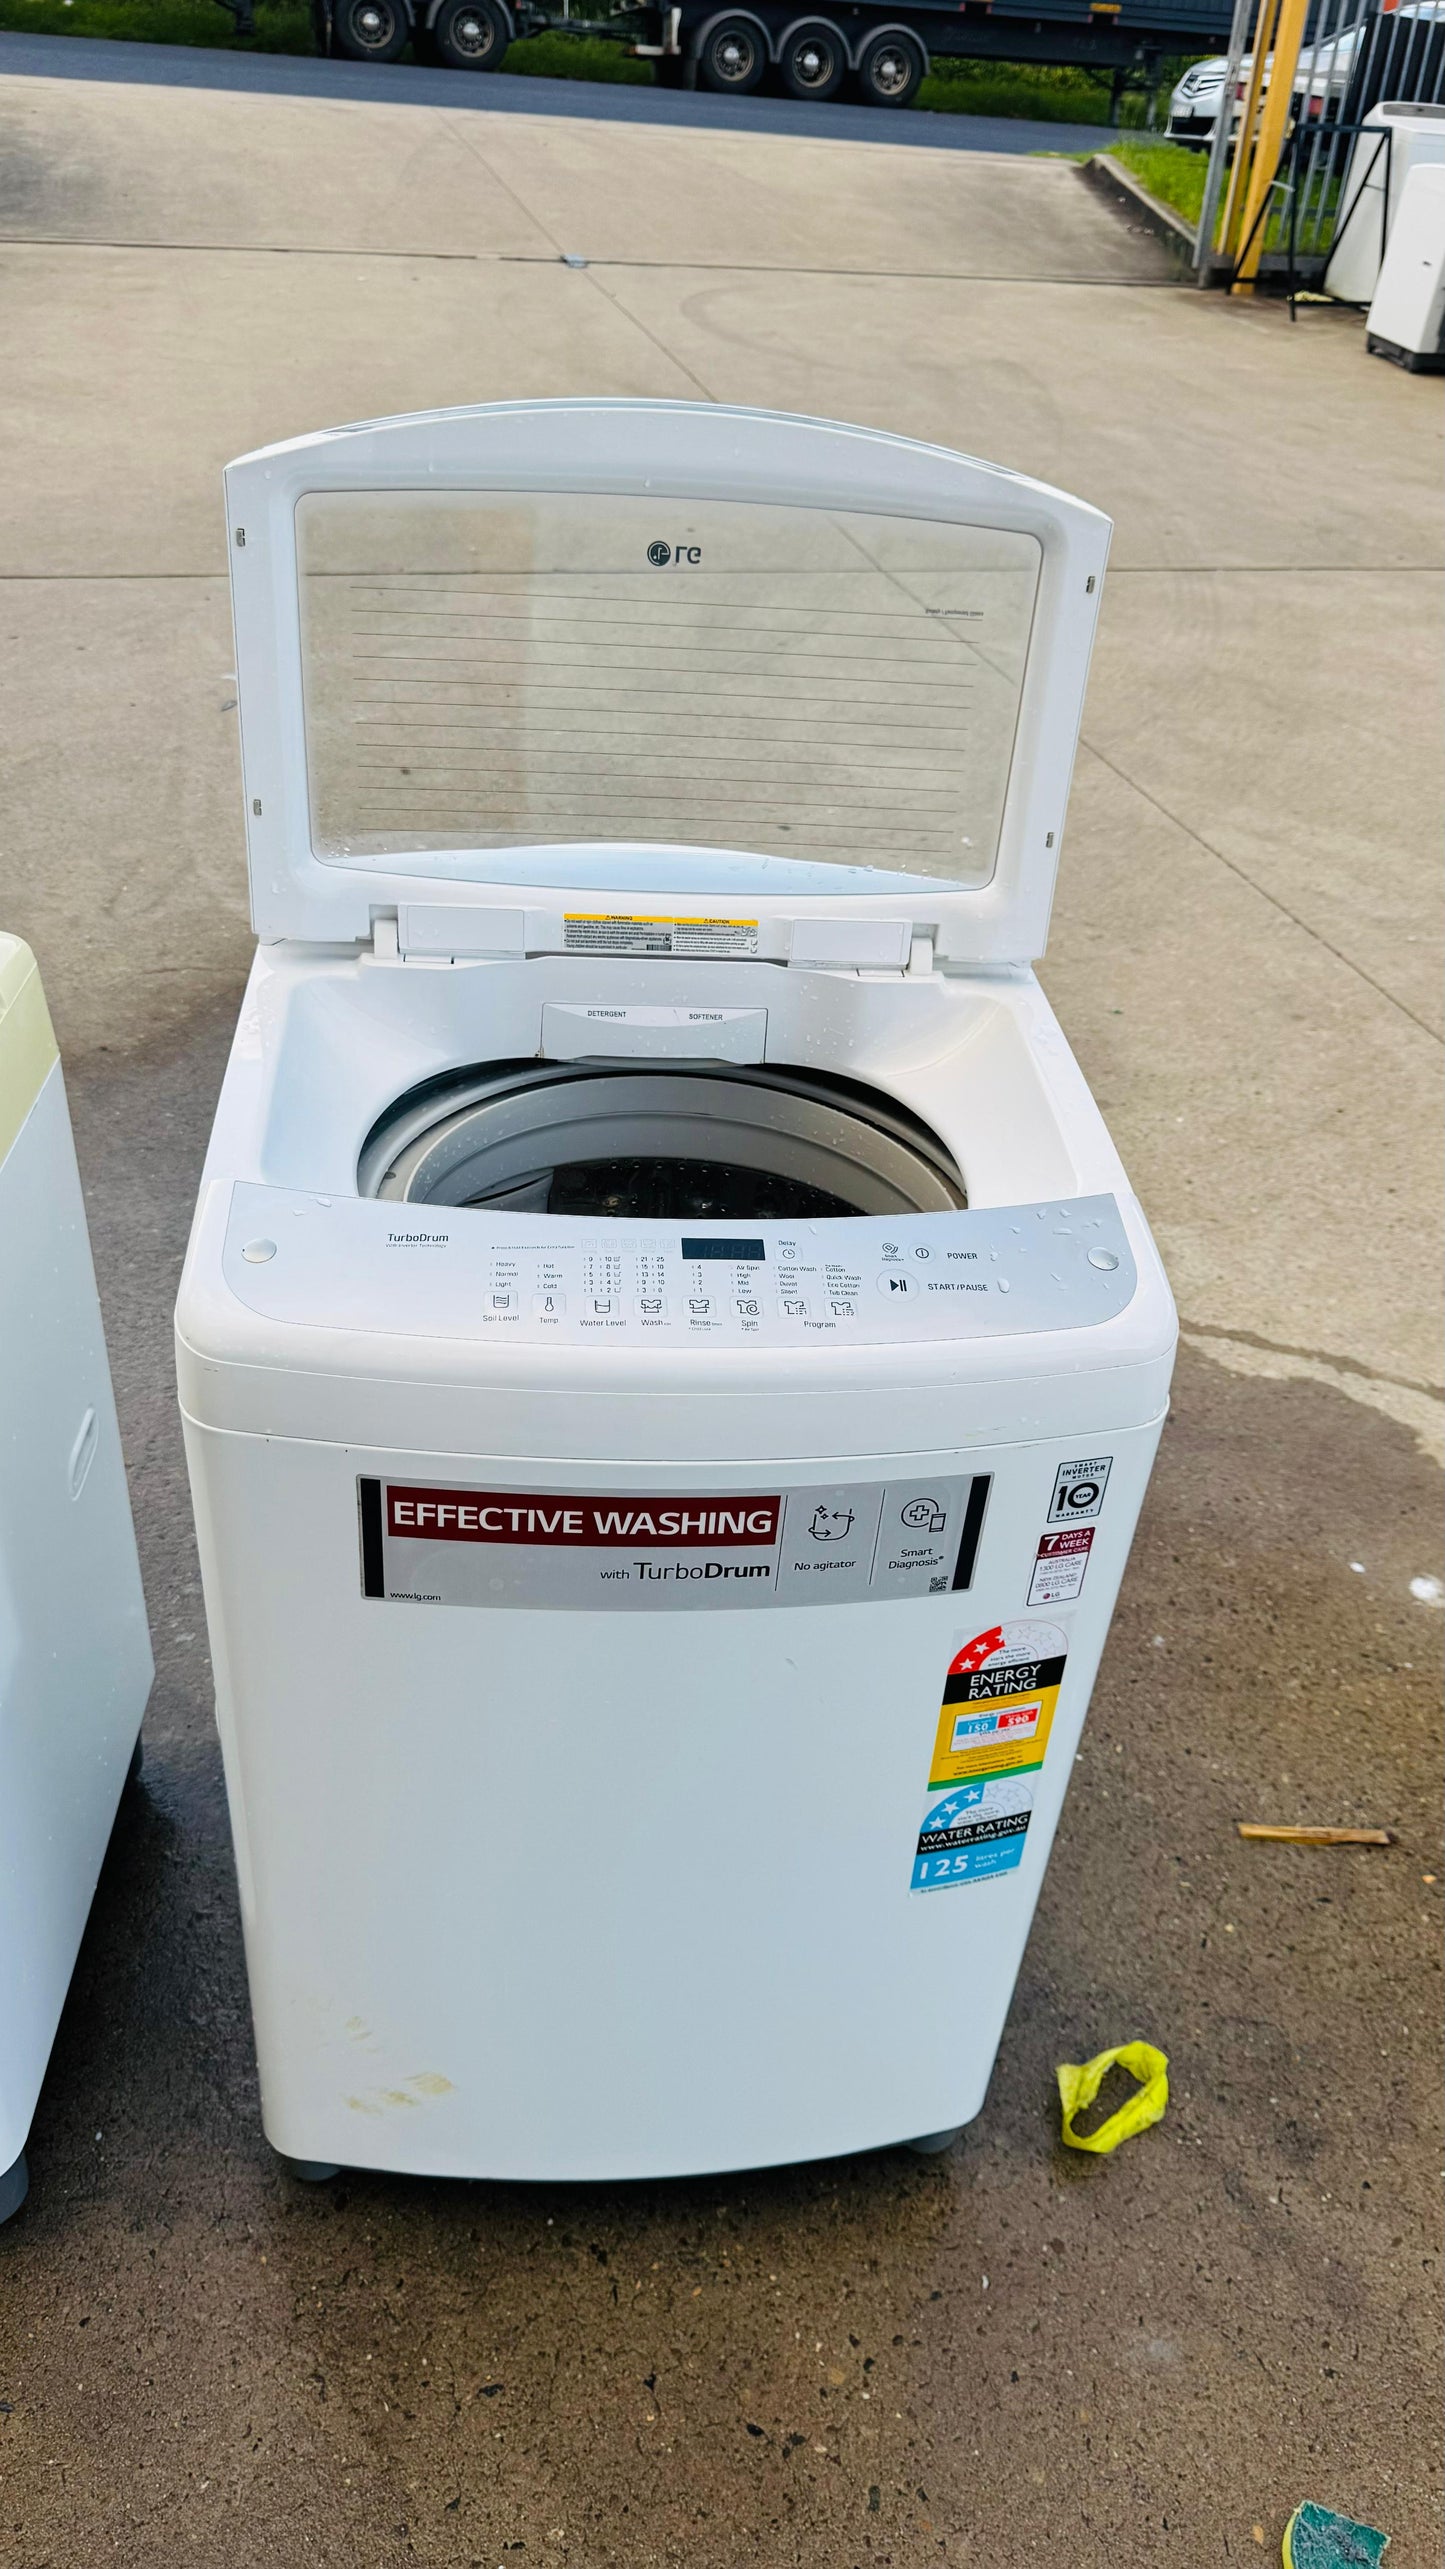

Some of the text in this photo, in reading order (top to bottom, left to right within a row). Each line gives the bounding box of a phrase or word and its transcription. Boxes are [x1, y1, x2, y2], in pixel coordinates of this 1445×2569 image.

[587, 1010, 627, 1018] DETERGENT
[688, 1013, 724, 1021] SOFTENER
[387, 1233, 449, 1243] TurboDrum
[947, 1252, 978, 1260] POWER
[928, 1283, 989, 1292] START/PAUSE
[482, 1314, 520, 1322] Soil Level
[539, 1316, 559, 1324] Temp
[580, 1319, 627, 1327] Water Level
[641, 1319, 664, 1327] Wash
[690, 1319, 711, 1327] Rinse
[741, 1319, 758, 1328] Spin
[803, 1320, 837, 1329] Program
[1062, 1464, 1106, 1476] INVERTER
[1056, 1482, 1100, 1511] 10
[393, 1500, 773, 1536] EFFECTIVE WASHING
[1055, 1508, 1094, 1518] WARRANTY
[1061, 1531, 1084, 1541] DAYS
[1044, 1535, 1060, 1551] 7
[1059, 1538, 1090, 1550] WEEK
[900, 1547, 933, 1558] Smart
[794, 1559, 857, 1572] No agitator
[1065, 1560, 1082, 1569] CARE
[600, 1562, 771, 1581] with TurboDrum
[390, 1592, 441, 1602] www.lg.com
[970, 1663, 1042, 1687] ENERGY
[968, 1678, 1038, 1700] RATING
[1007, 1714, 1030, 1727] 590
[968, 1722, 989, 1734] 150
[921, 1814, 1029, 1844] WATER RATING
[920, 1824, 1027, 1851] www.waterrating.gov.au
[1000, 1848, 1015, 1857] per
[920, 1854, 969, 1880] 125
[974, 1860, 997, 1869] wash
